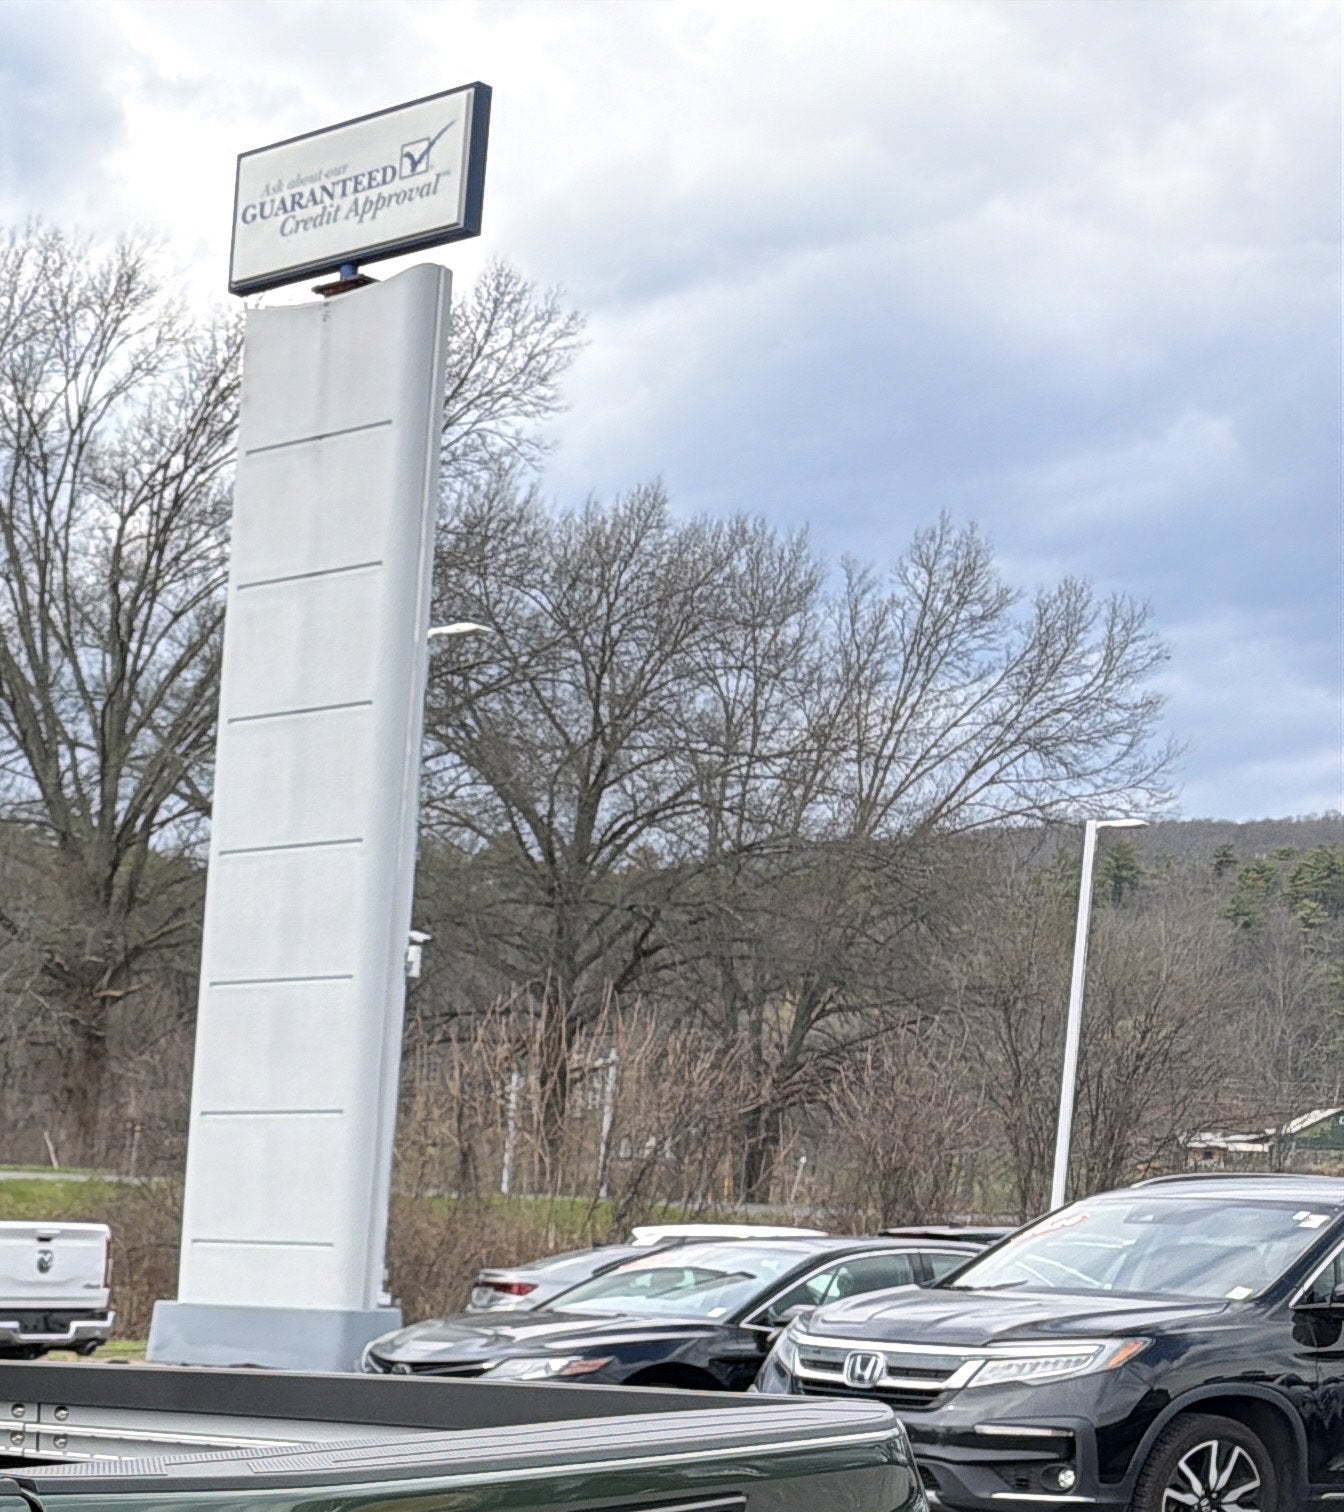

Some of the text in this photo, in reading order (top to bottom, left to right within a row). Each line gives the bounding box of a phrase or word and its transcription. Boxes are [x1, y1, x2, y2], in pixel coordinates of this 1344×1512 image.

[286, 169, 322, 190] about
[323, 163, 349, 179] our
[241, 164, 397, 225] GUARANTEED
[279, 204, 341, 237] Credit
